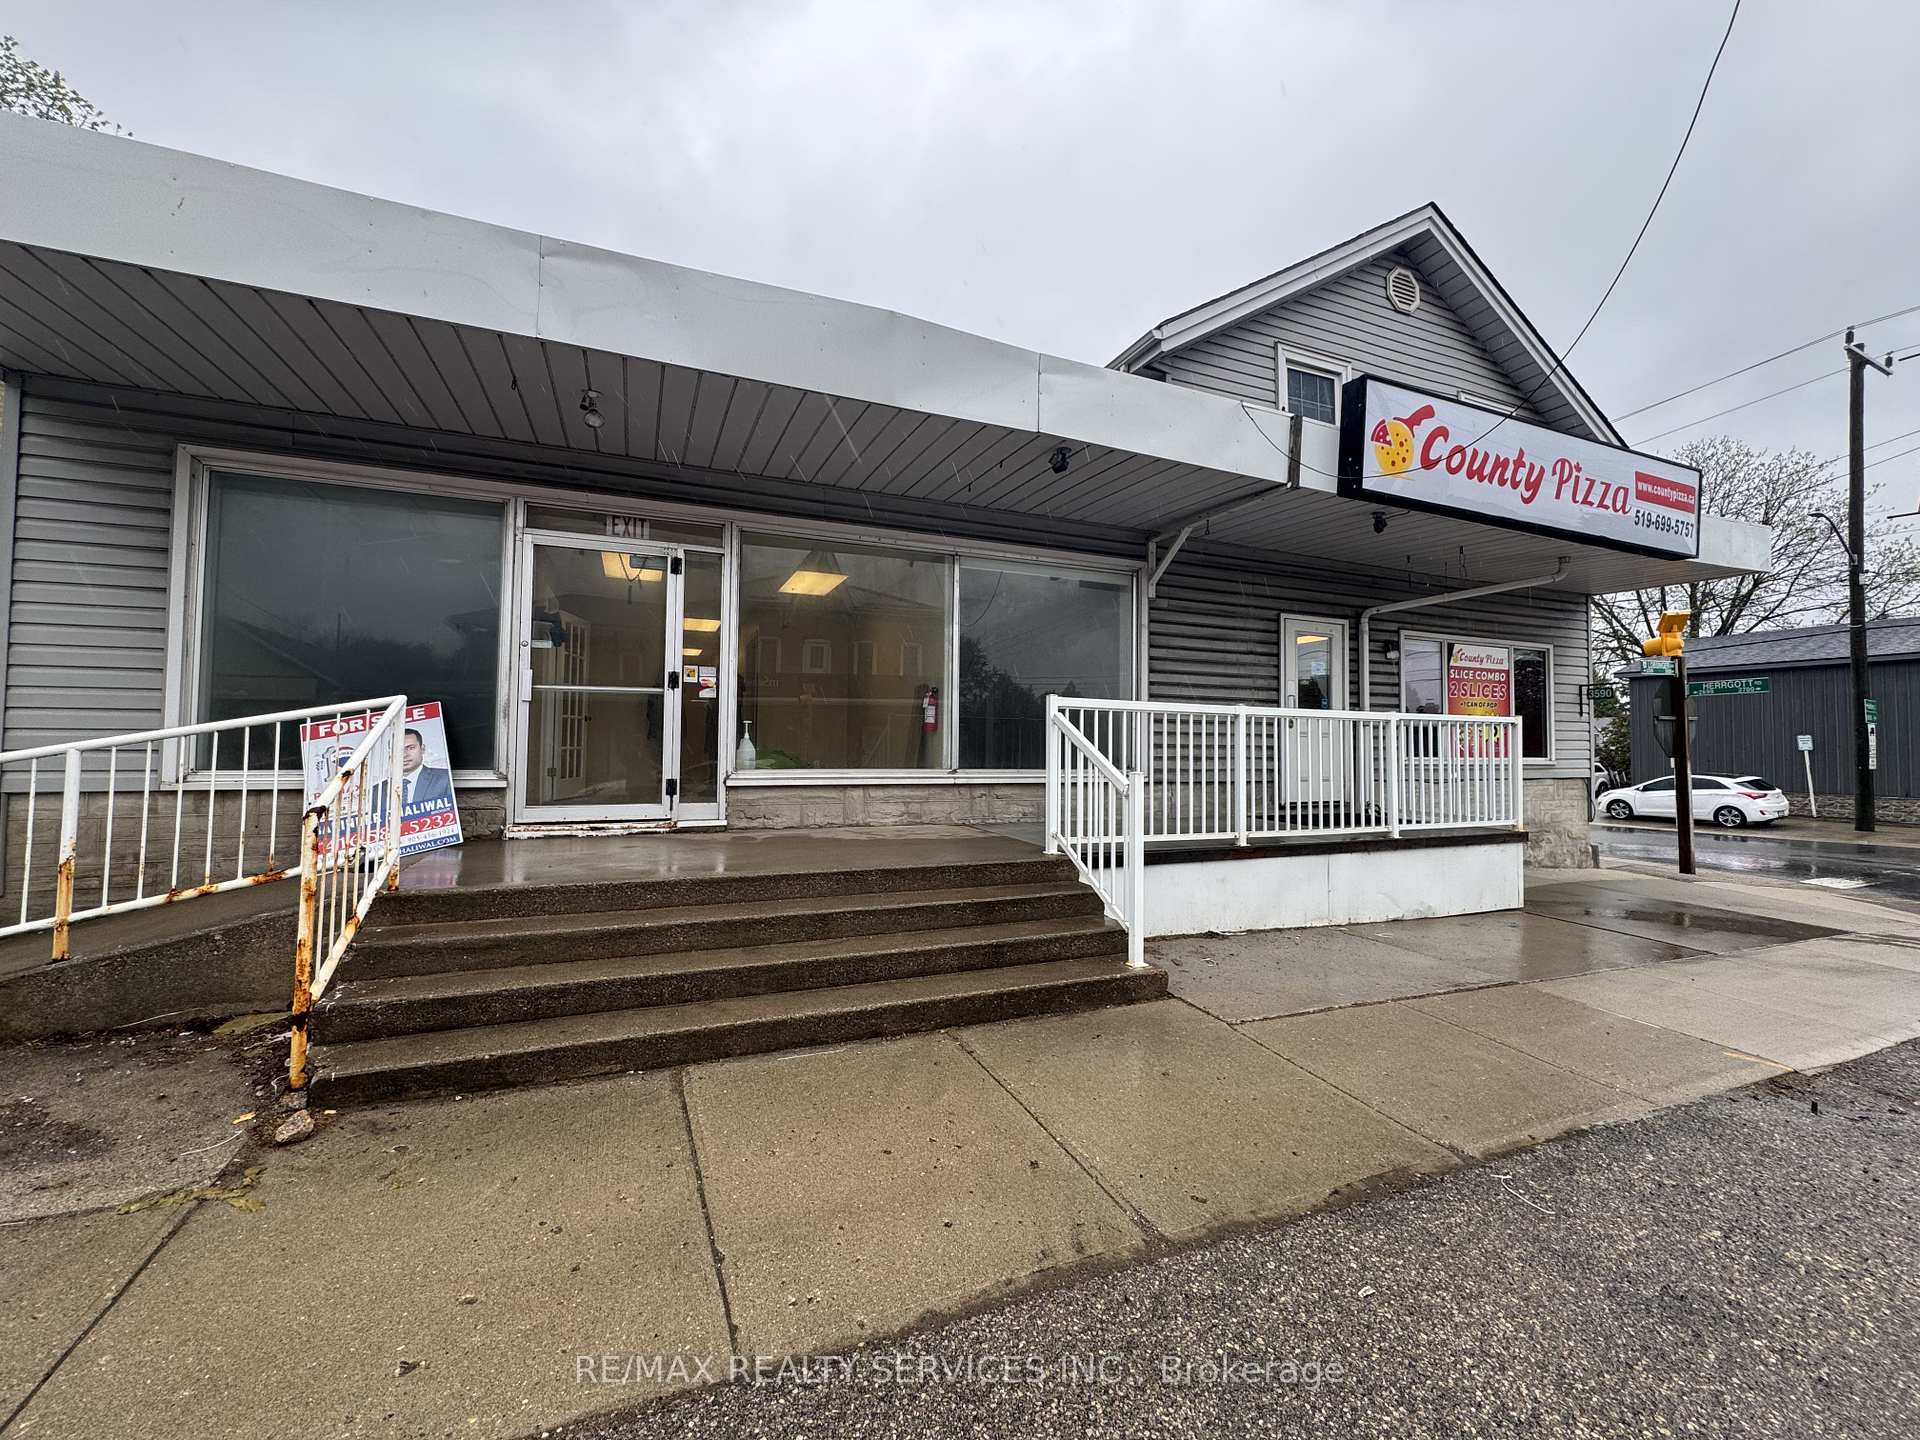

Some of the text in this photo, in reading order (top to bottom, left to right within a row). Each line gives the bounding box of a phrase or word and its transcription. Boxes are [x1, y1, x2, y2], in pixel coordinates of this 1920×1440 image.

[1420, 426, 1633, 515] County Pizza
[1637, 481, 1695, 505] www.countypizza.ca
[612, 516, 647, 538] EXIT
[1634, 509, 1694, 539] 519-699-5757
[1459, 652, 1484, 666] County
[1450, 669, 1506, 681] SLICE COMBO
[1450, 681, 1507, 700] 2 SLICES
[1588, 689, 1613, 698] 3590
[319, 719, 364, 737] FOR
